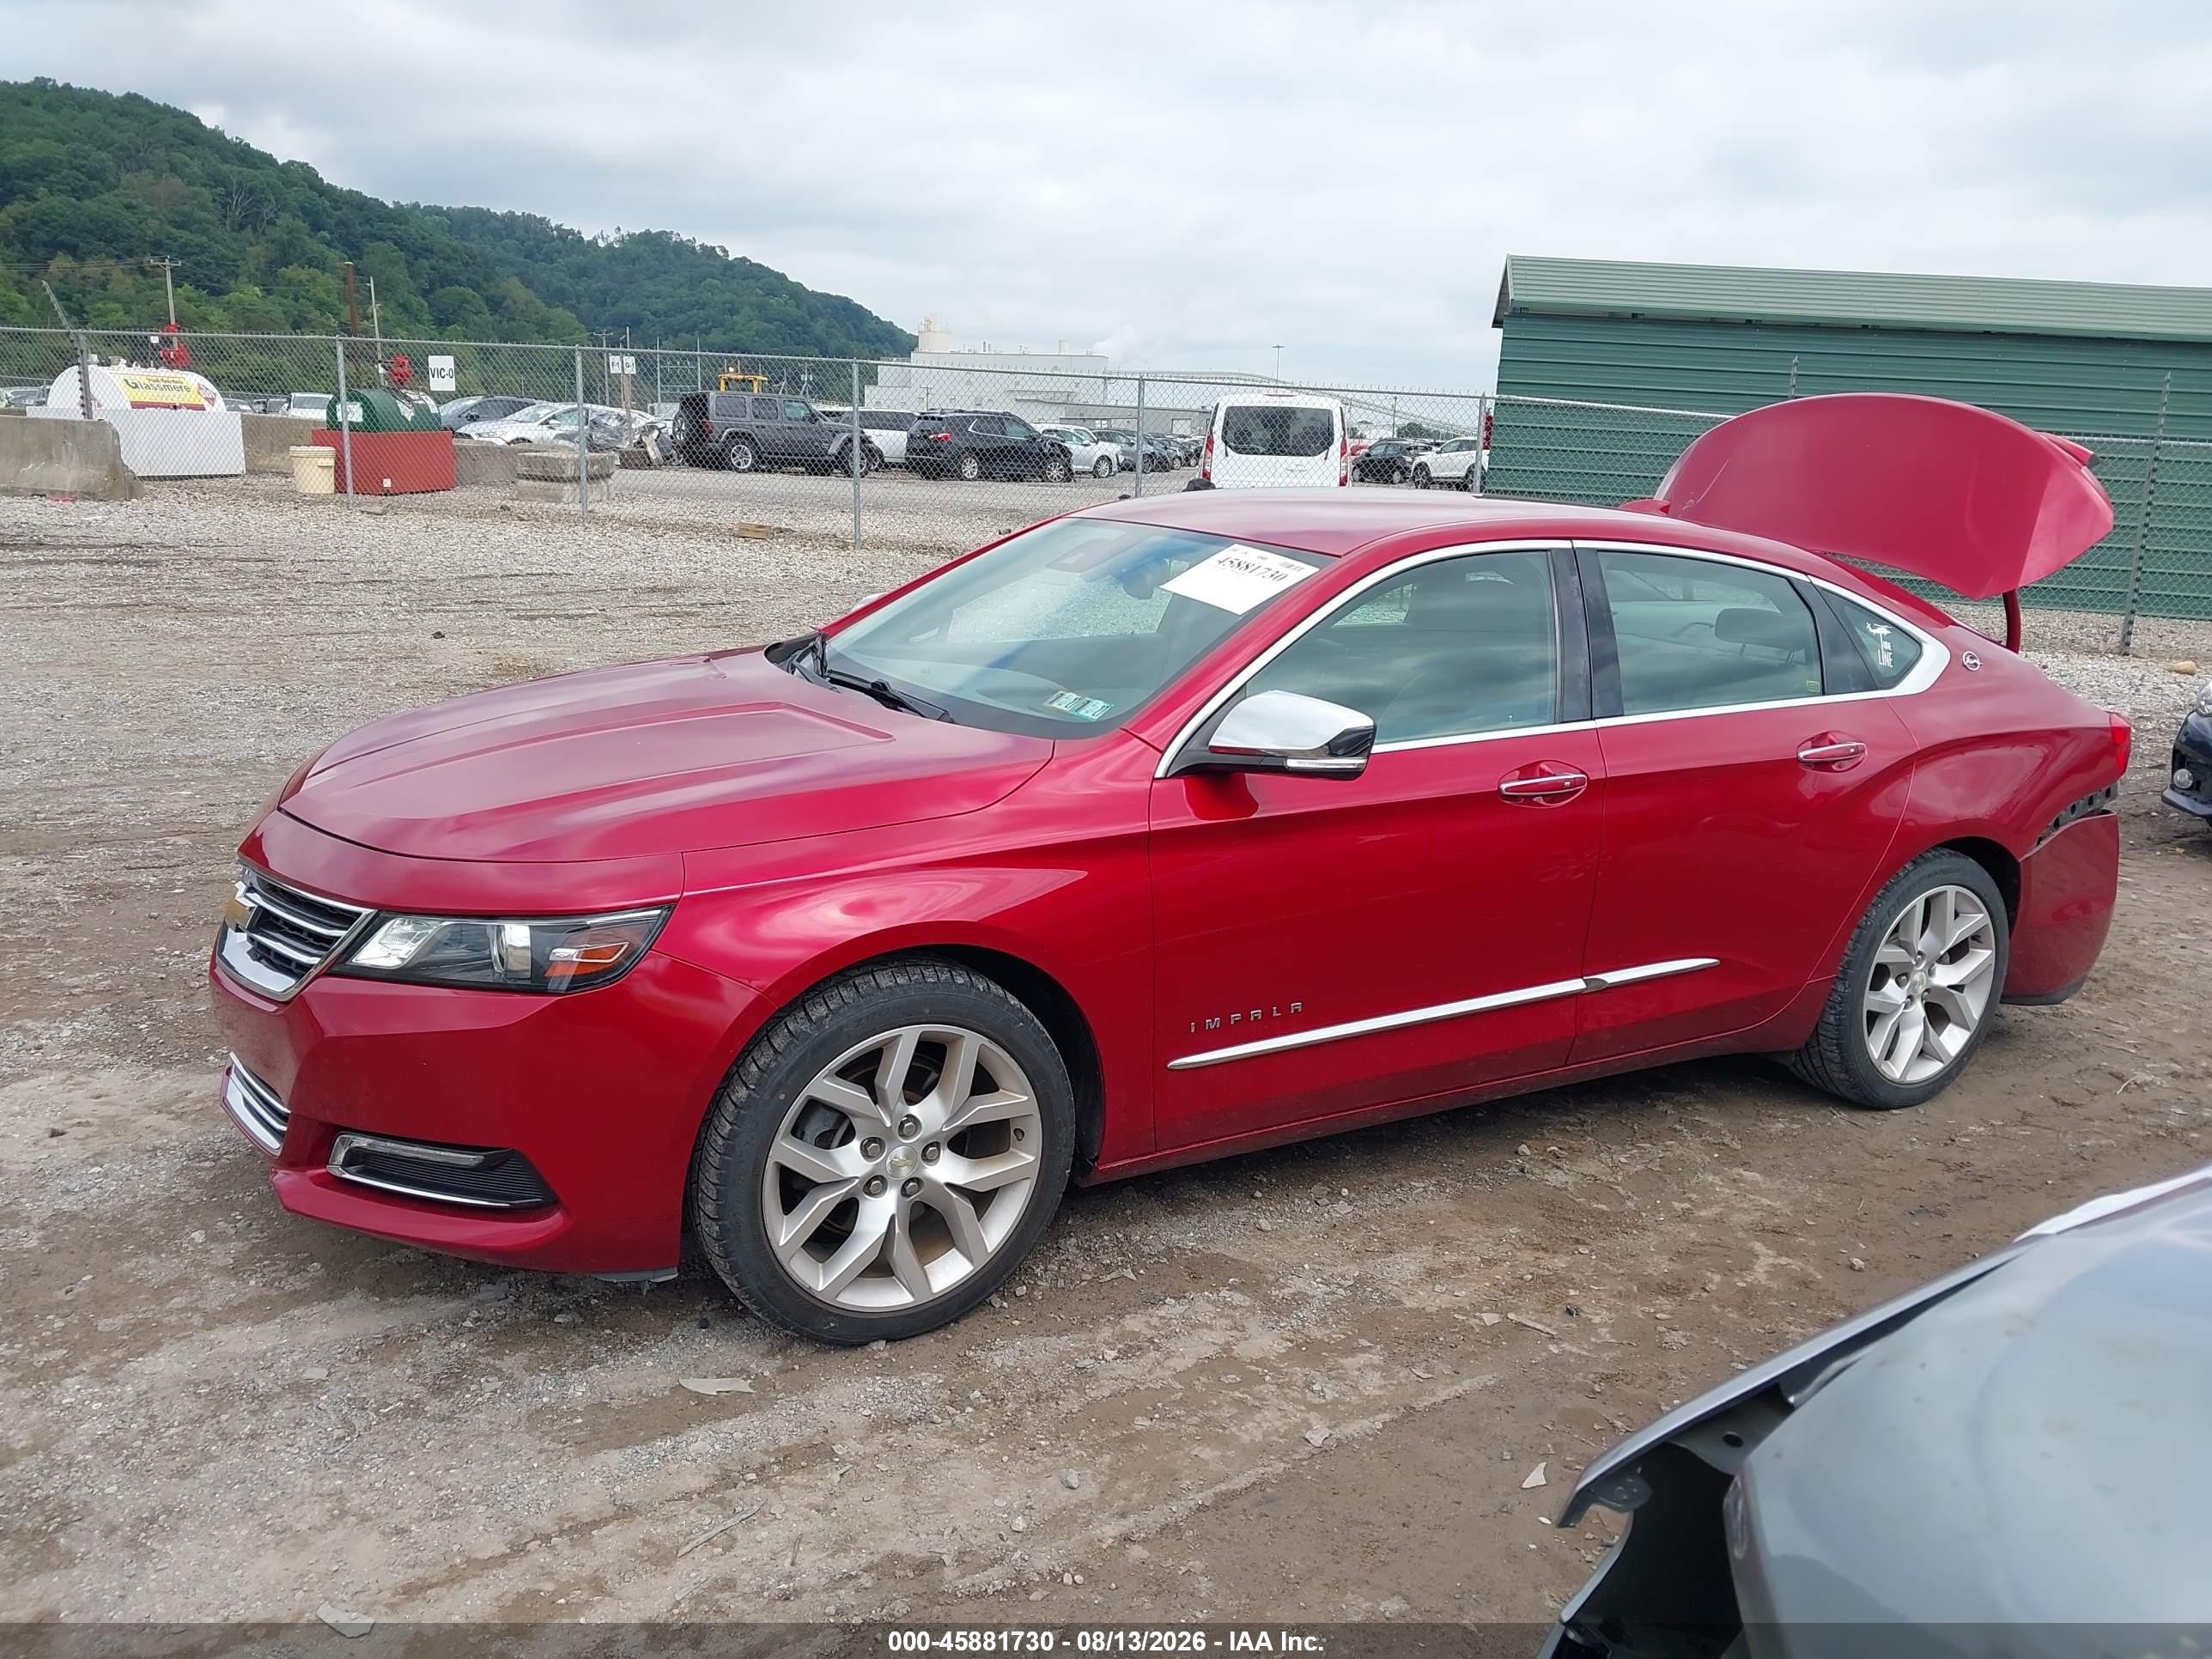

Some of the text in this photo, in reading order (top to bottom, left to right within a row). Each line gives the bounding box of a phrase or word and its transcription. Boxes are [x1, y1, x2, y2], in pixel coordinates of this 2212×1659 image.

[124, 378, 191, 392] Glassmere
[1217, 556, 1289, 582] 45881730
[1190, 1001, 1303, 1033] IMPALA
